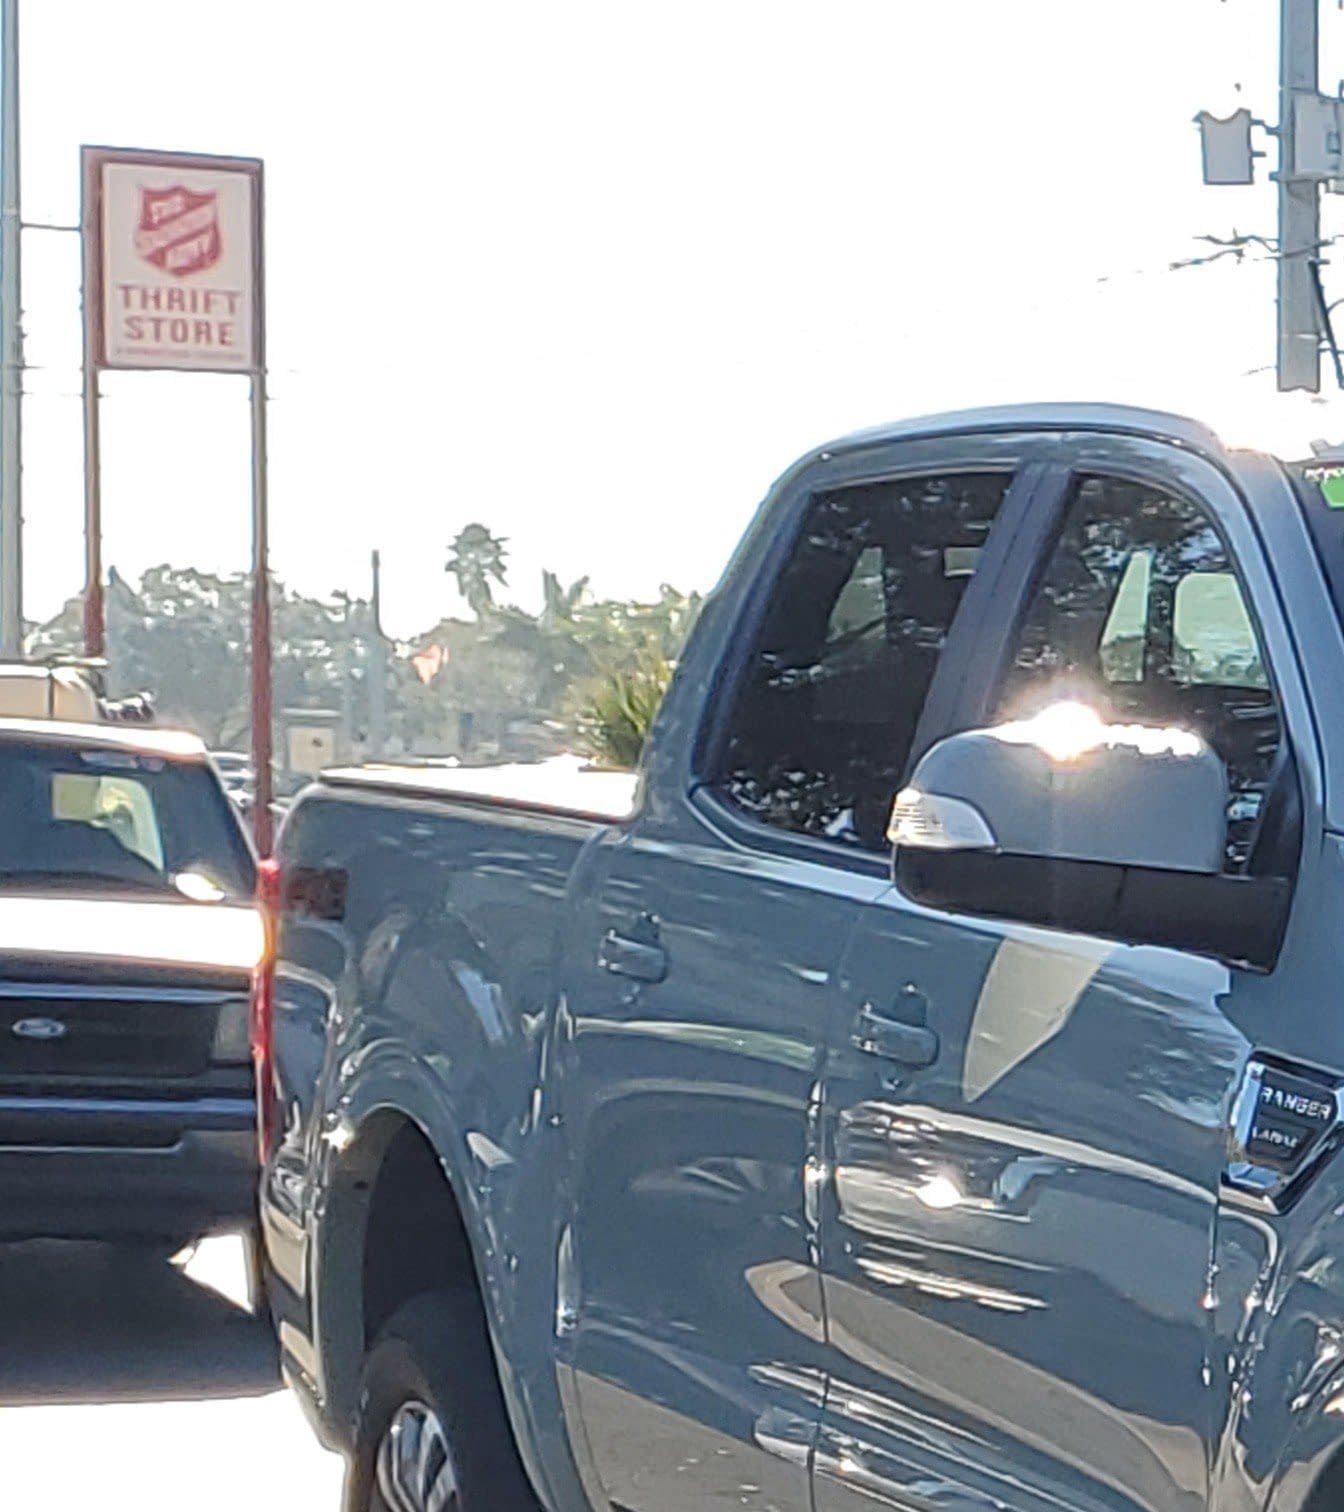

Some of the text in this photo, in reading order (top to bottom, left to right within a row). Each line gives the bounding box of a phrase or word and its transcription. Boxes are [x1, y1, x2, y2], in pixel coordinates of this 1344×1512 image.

[117, 283, 241, 315] THRIFT
[124, 315, 234, 347] STORE
[1261, 1085, 1332, 1121] RANGER
